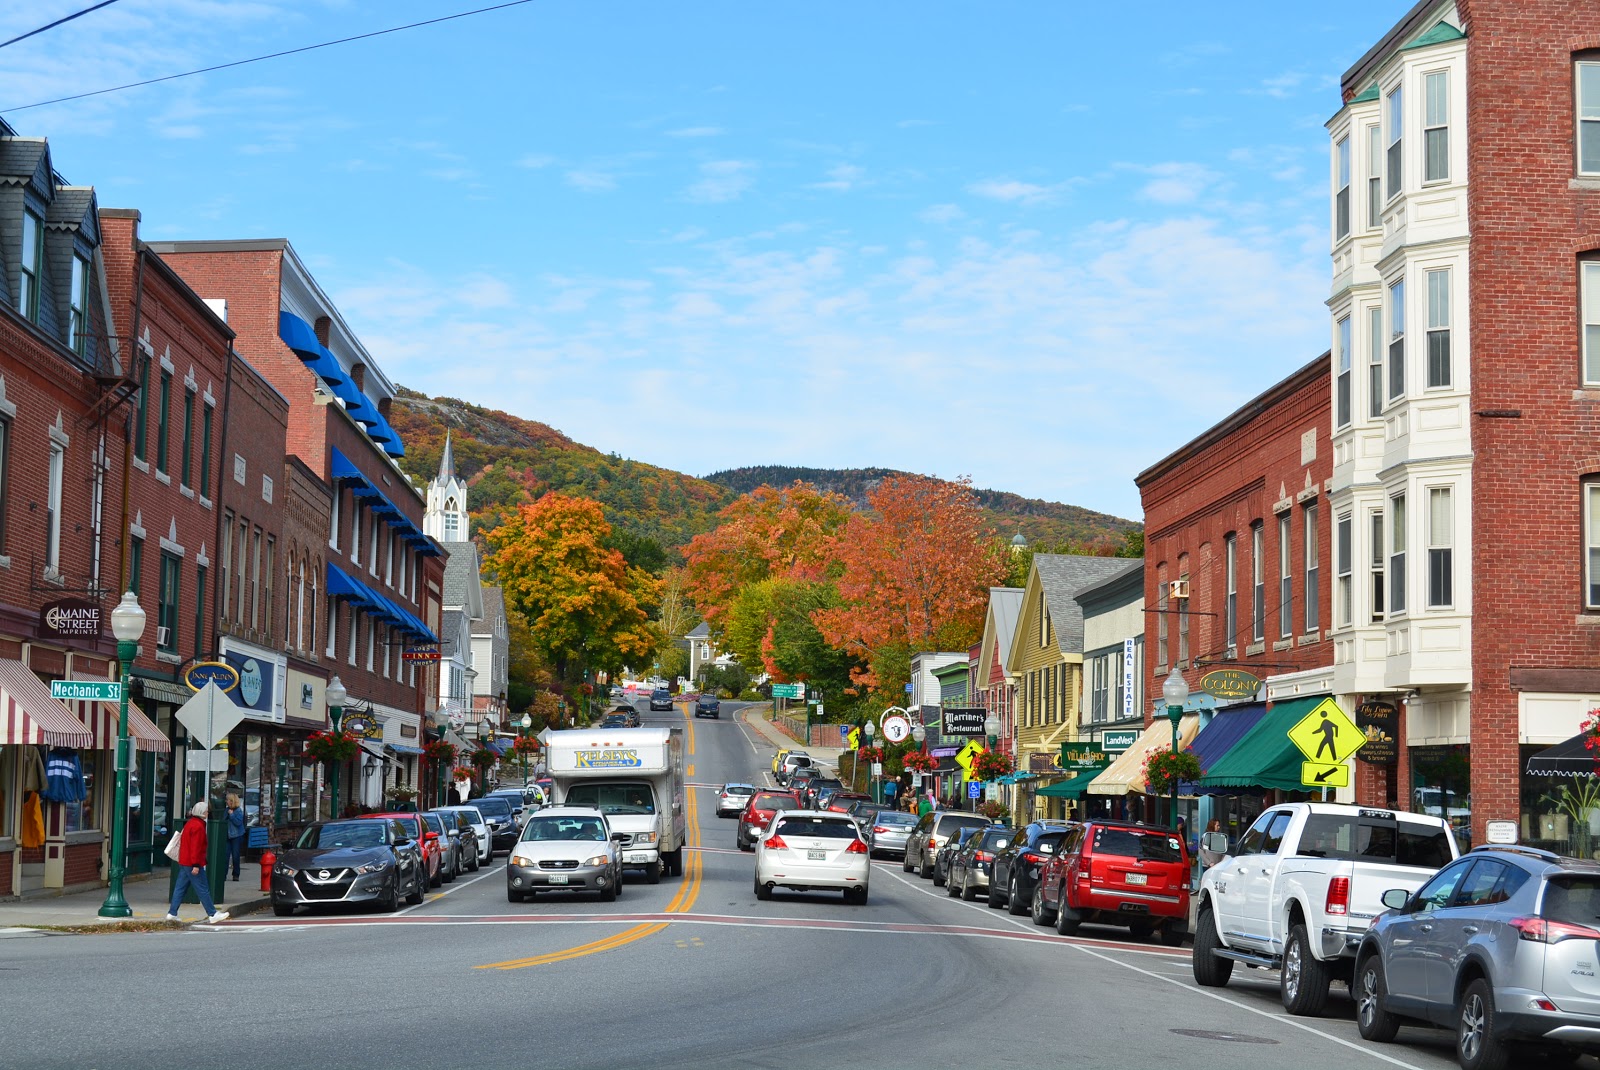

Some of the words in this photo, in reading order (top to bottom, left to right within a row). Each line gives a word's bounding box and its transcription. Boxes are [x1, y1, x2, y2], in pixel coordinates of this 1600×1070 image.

[60, 608, 100, 619] MAINE
[59, 619, 100, 629] STREET
[1204, 678, 1258, 690] COLONY
[54, 683, 100, 697] Mechanic
[108, 685, 118, 697] St
[944, 712, 985, 724] Marriner's
[946, 723, 983, 734] Restaurant
[1106, 735, 1134, 745] LandVest
[1067, 752, 1090, 761] VILLAGE
[1090, 751, 1106, 761] SHOP
